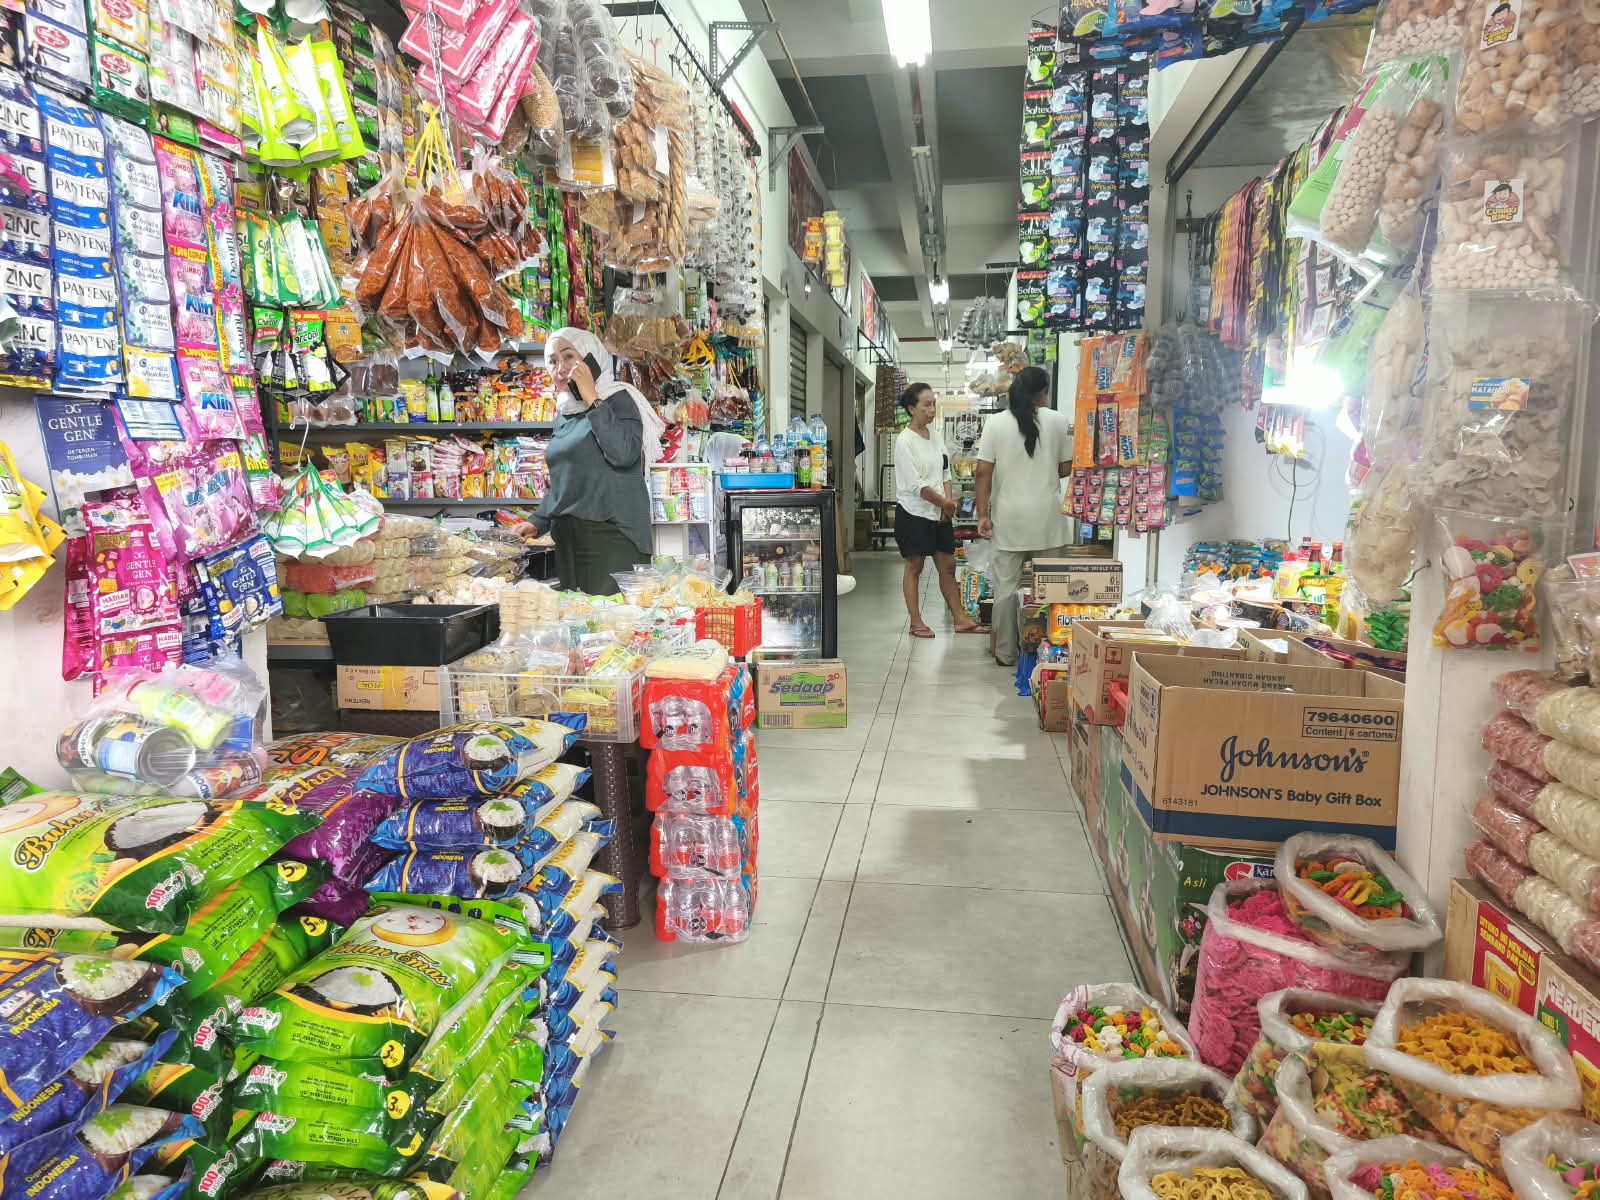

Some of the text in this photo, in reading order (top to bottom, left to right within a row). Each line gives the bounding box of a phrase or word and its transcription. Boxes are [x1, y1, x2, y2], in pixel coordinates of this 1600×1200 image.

[1030, 44, 1053, 52] Softex
[1025, 105, 1050, 115] Softex
[51, 123, 104, 154] PANTENE
[55, 177, 106, 204] PANTENE
[58, 229, 109, 254] PANTENE
[6, 266, 43, 290] ZINC
[62, 280, 114, 305] PANTENE
[1018, 286, 1043, 294] Softex
[65, 332, 117, 352] PANTENE
[201, 392, 233, 411] Klin
[48, 415, 103, 430] GENTLE
[64, 430, 94, 442] GEN
[126, 559, 157, 571] GENTLE
[132, 569, 153, 579] GEN
[1211, 670, 1254, 680] DIBANTING
[768, 680, 836, 695] Sedaap
[1231, 680, 1259, 688] MUDAH
[1307, 711, 1395, 726] 79640600
[1305, 726, 1344, 738] Content
[1357, 730, 1394, 740] cartons
[1219, 735, 1369, 783] Johnson's
[1162, 797, 1199, 808] 6143181
[1201, 784, 1382, 808] JOHNSON'S Baby Gift Box
[1184, 876, 1207, 889] Asli
[393, 949, 453, 989] Emas
[10, 998, 62, 1036] INDONESIA
[10, 1081, 63, 1123] INDONESIA
[24, 1154, 80, 1199] INDONESIA
[198, 1170, 219, 1193] 100
